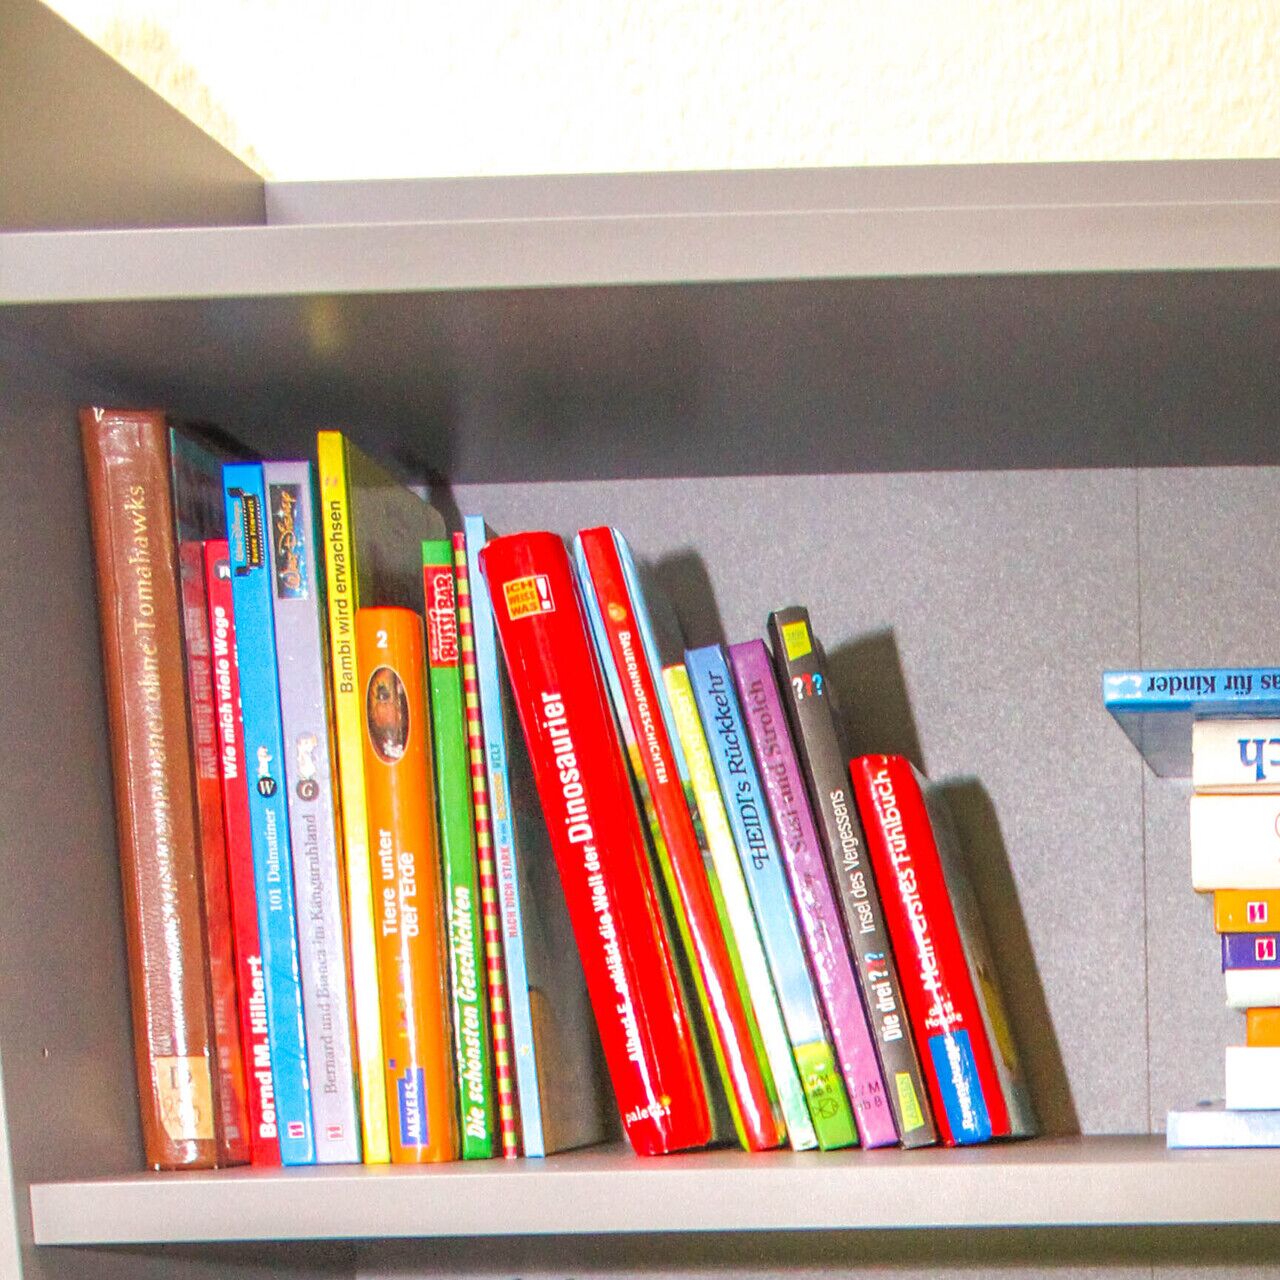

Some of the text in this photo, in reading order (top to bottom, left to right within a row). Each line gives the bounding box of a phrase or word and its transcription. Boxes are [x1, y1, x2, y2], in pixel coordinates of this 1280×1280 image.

[124, 486, 157, 636] Tomahawks
[329, 499, 354, 694] Bambi wird erwachsen
[376, 630, 388, 649] 2
[214, 606, 238, 779] Wie mich viele Wege
[618, 631, 669, 784] BAUERNHOFGESCHICHTEN
[1147, 675, 1217, 694] Kinder
[1224, 674, 1253, 693] für
[541, 692, 614, 938] die Welt der Dinosaurier
[708, 670, 770, 870] HEIDI's Rückkehr
[264, 808, 282, 911] 101 Dalmatiner
[379, 829, 398, 937] Tiere unter
[830, 790, 903, 1042] Die drei Insel des Vergessens
[248, 955, 277, 1139] Bernd M. Hilbert
[453, 886, 486, 1141] Die schönsten Geschichten
